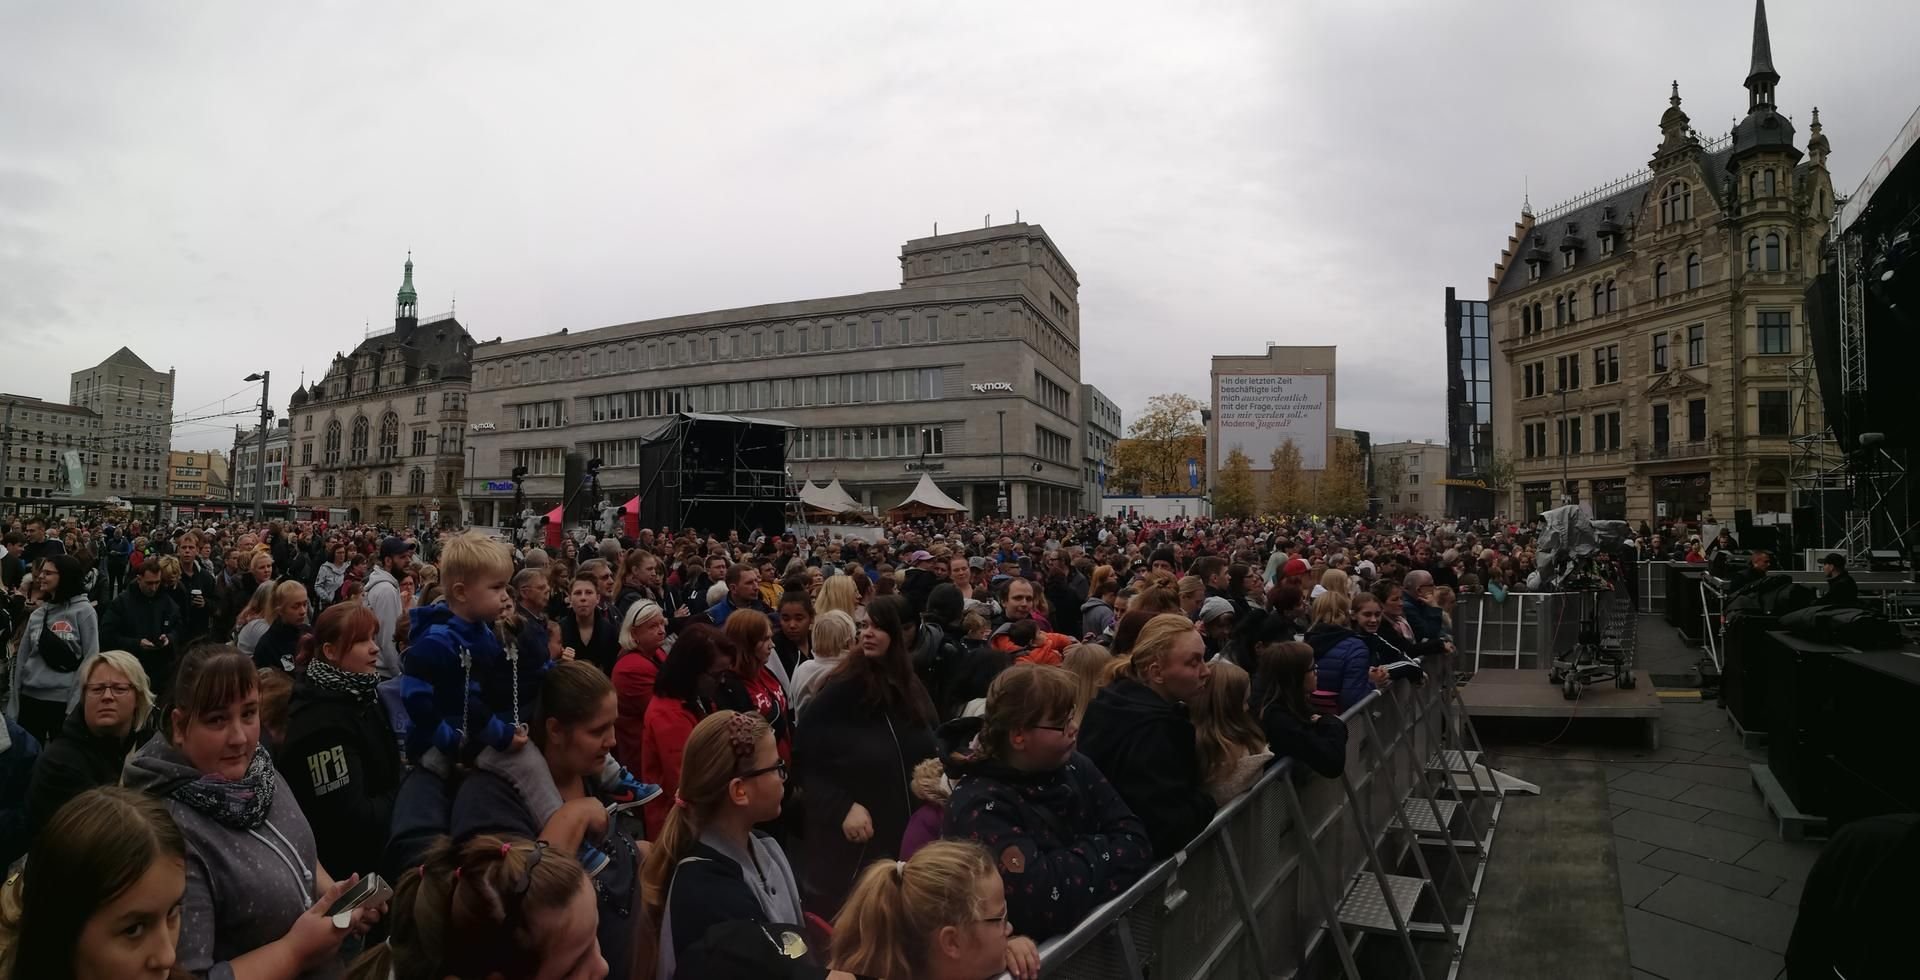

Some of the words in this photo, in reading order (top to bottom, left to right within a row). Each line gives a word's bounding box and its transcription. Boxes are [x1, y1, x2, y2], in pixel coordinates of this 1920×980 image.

[1221, 385, 1270, 395] beschäftigte
[1249, 403, 1274, 412] Frage,
[1292, 402, 1322, 410] einmal
[1255, 419, 1292, 429] Jugend?
